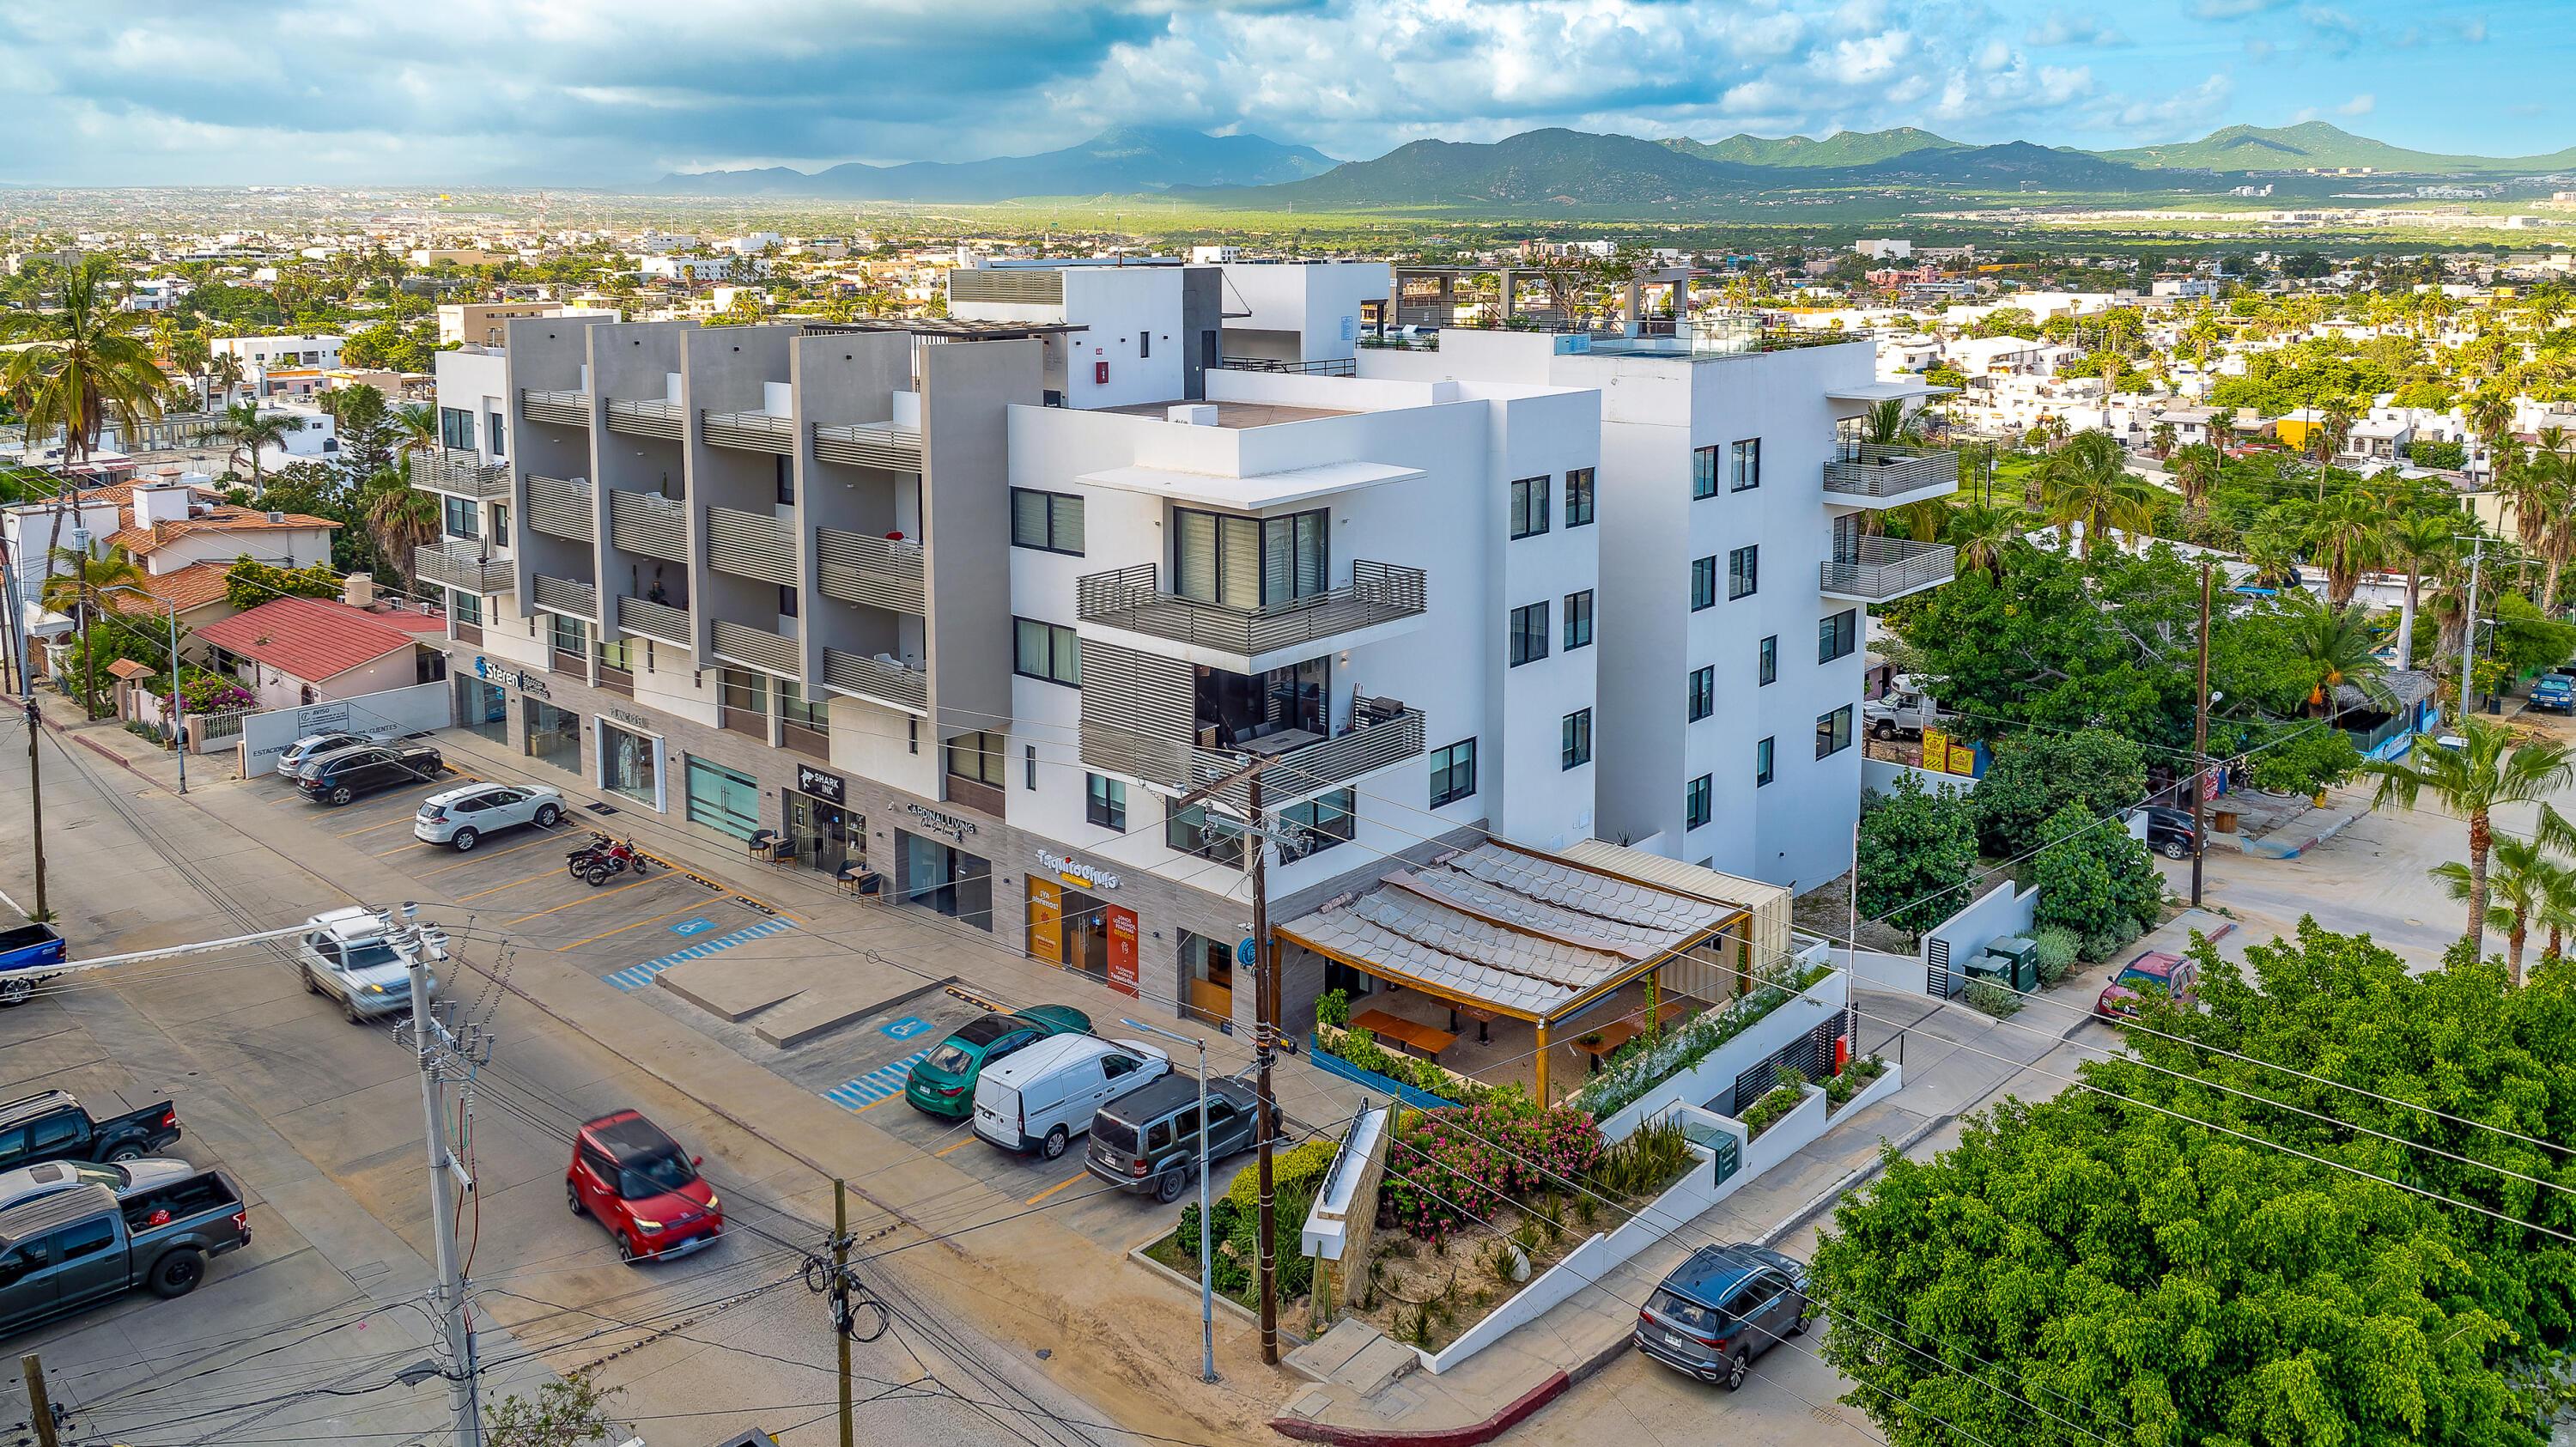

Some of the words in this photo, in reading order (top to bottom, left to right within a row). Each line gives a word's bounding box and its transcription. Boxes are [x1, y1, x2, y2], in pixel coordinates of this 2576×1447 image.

[486, 662, 519, 687] Steren
[313, 708, 330, 716] AVISO
[369, 724, 398, 733] CLIENTES
[815, 773, 839, 789] SHARK
[822, 784, 834, 795] INK
[906, 803, 946, 824] CARDINAL
[946, 816, 976, 834] LIVING
